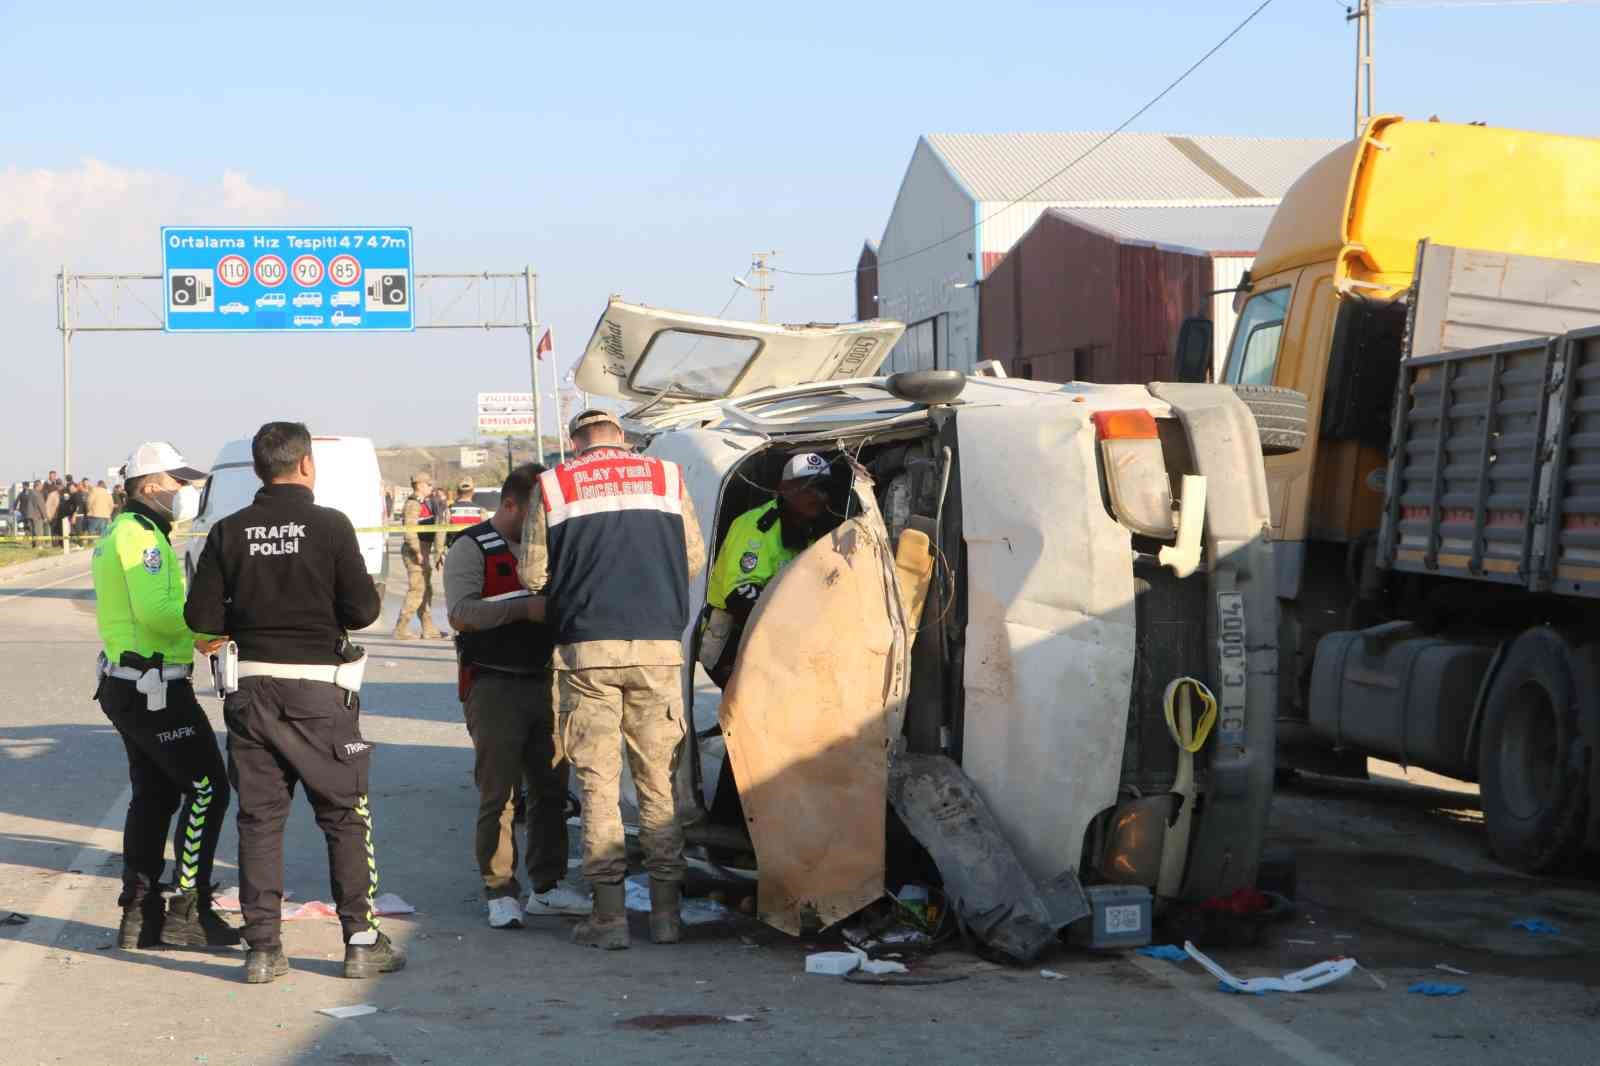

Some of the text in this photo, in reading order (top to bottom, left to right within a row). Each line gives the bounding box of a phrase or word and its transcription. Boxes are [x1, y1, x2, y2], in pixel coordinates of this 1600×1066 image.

[169, 235, 245, 248] Ortalama
[287, 235, 337, 252] Tespiti
[223, 264, 244, 278] 110
[260, 264, 281, 278] 100
[298, 264, 317, 278] 90
[335, 264, 353, 278] 85
[574, 467, 610, 482] OLAY
[244, 522, 306, 539] TRAFİK
[1224, 673, 1244, 688] C
[1222, 705, 1243, 731] 31
